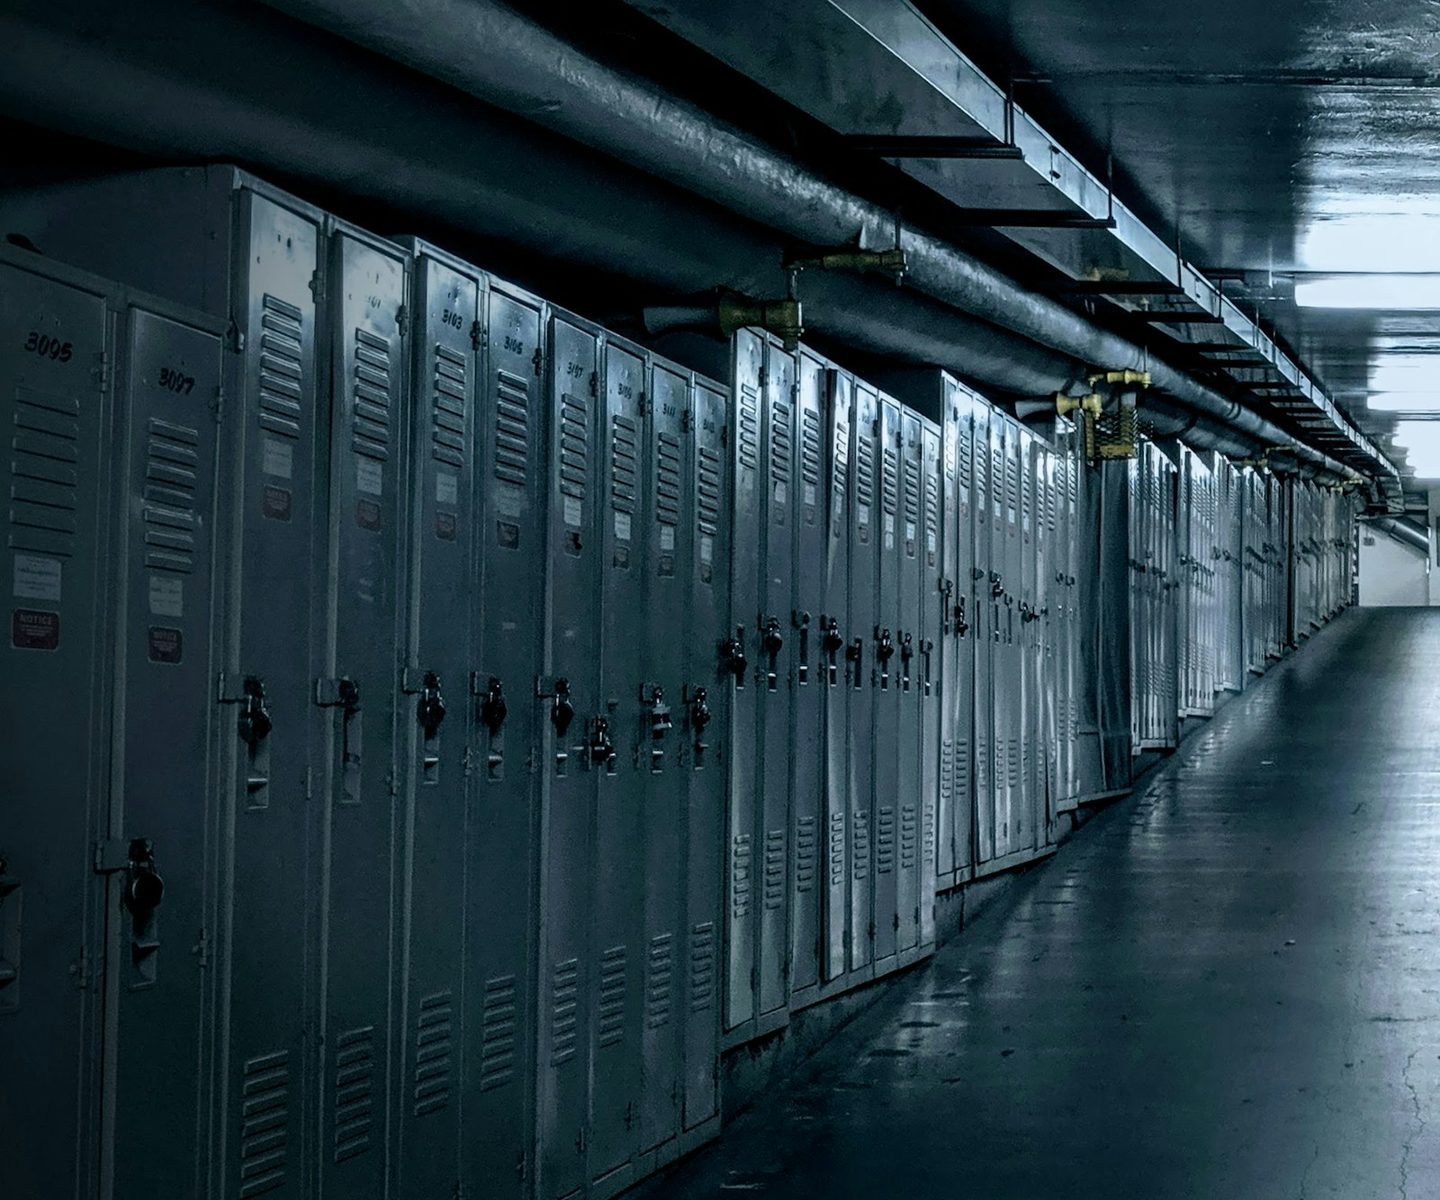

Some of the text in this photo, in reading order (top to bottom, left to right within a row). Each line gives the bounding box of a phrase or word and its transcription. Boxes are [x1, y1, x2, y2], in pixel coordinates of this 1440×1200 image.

[442, 309, 463, 330] 3103
[24, 332, 73, 362] 3095
[159, 368, 195, 395] 3097
